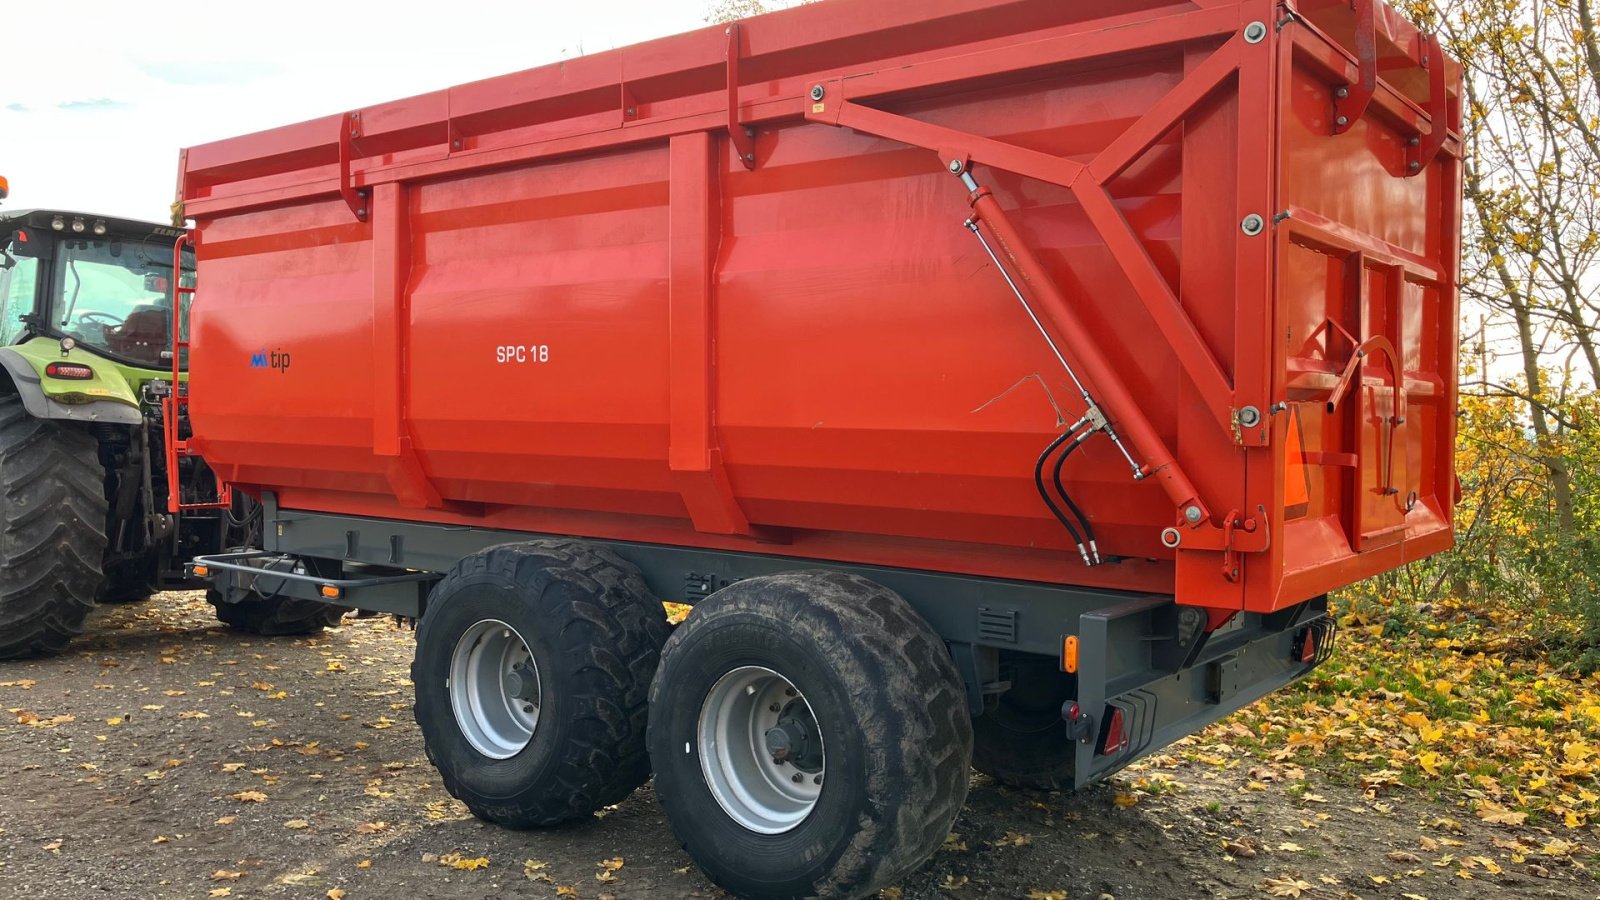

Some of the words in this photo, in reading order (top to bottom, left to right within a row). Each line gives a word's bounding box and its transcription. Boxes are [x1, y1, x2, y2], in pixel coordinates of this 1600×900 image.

[271, 348, 290, 374] tip
[496, 345, 526, 363] SPC
[530, 345, 549, 363] 18
